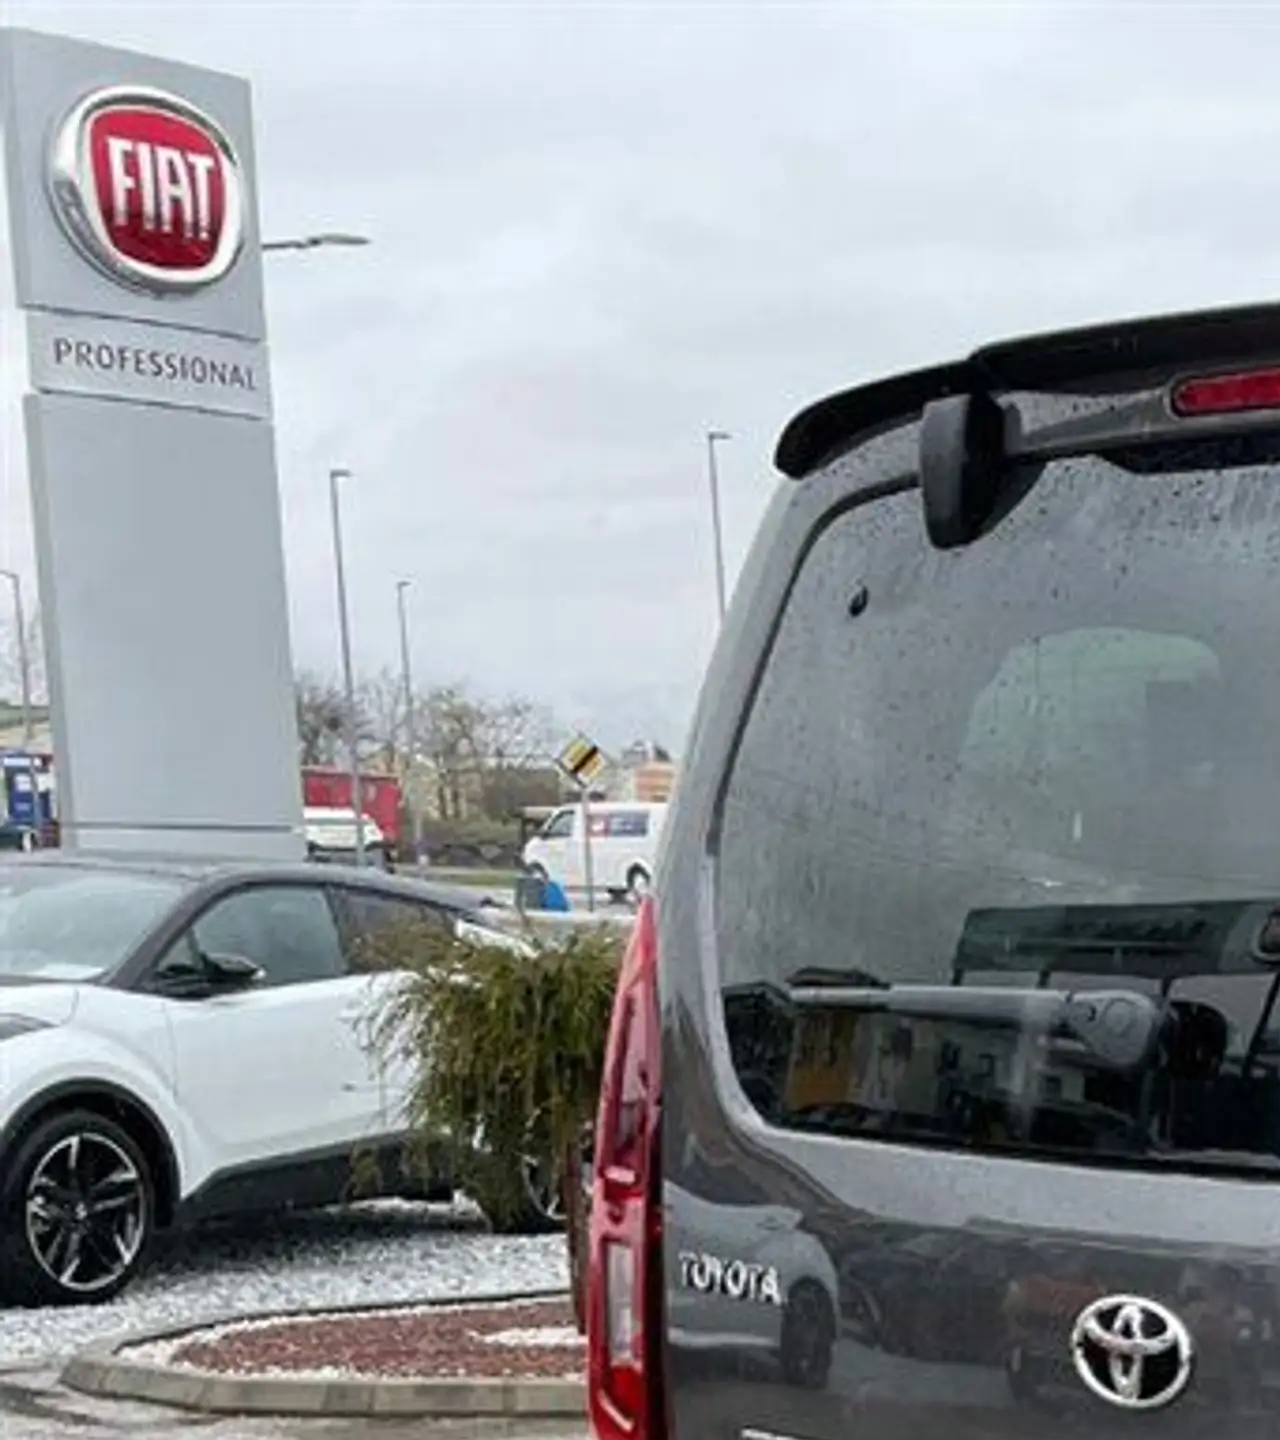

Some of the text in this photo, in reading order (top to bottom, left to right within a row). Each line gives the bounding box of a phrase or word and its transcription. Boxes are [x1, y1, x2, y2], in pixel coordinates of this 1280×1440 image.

[104, 136, 214, 240] FIAT
[54, 337, 257, 391] PROFESSIONAL
[678, 1250, 782, 1305] TOYOTA
